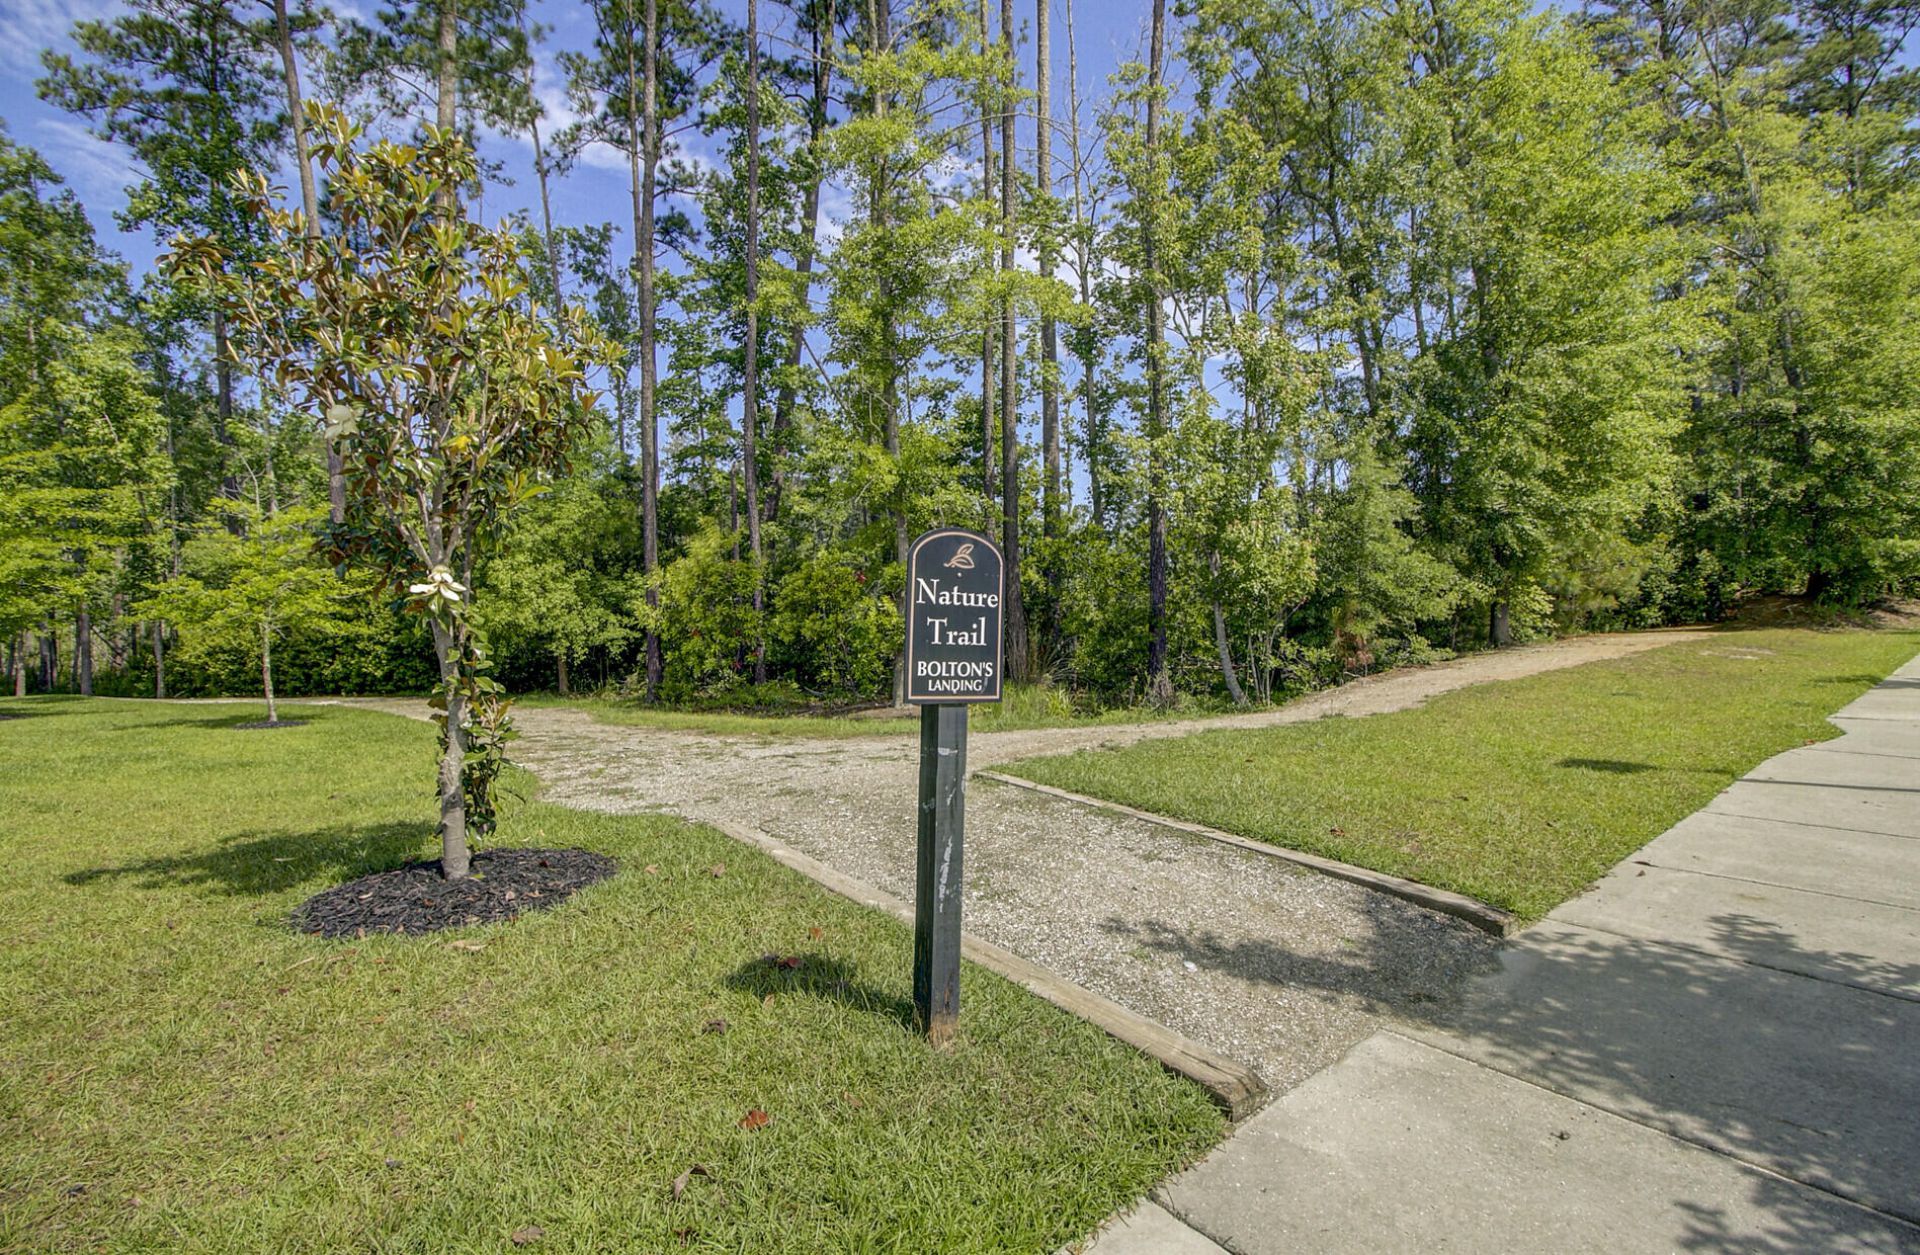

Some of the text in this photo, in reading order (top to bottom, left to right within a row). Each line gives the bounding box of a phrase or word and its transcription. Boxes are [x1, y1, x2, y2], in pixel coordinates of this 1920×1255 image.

[916, 578, 998, 608] Nature
[926, 617, 987, 646] Trail
[917, 661, 993, 677] BOLTON'S
[928, 679, 982, 692] LANDING
